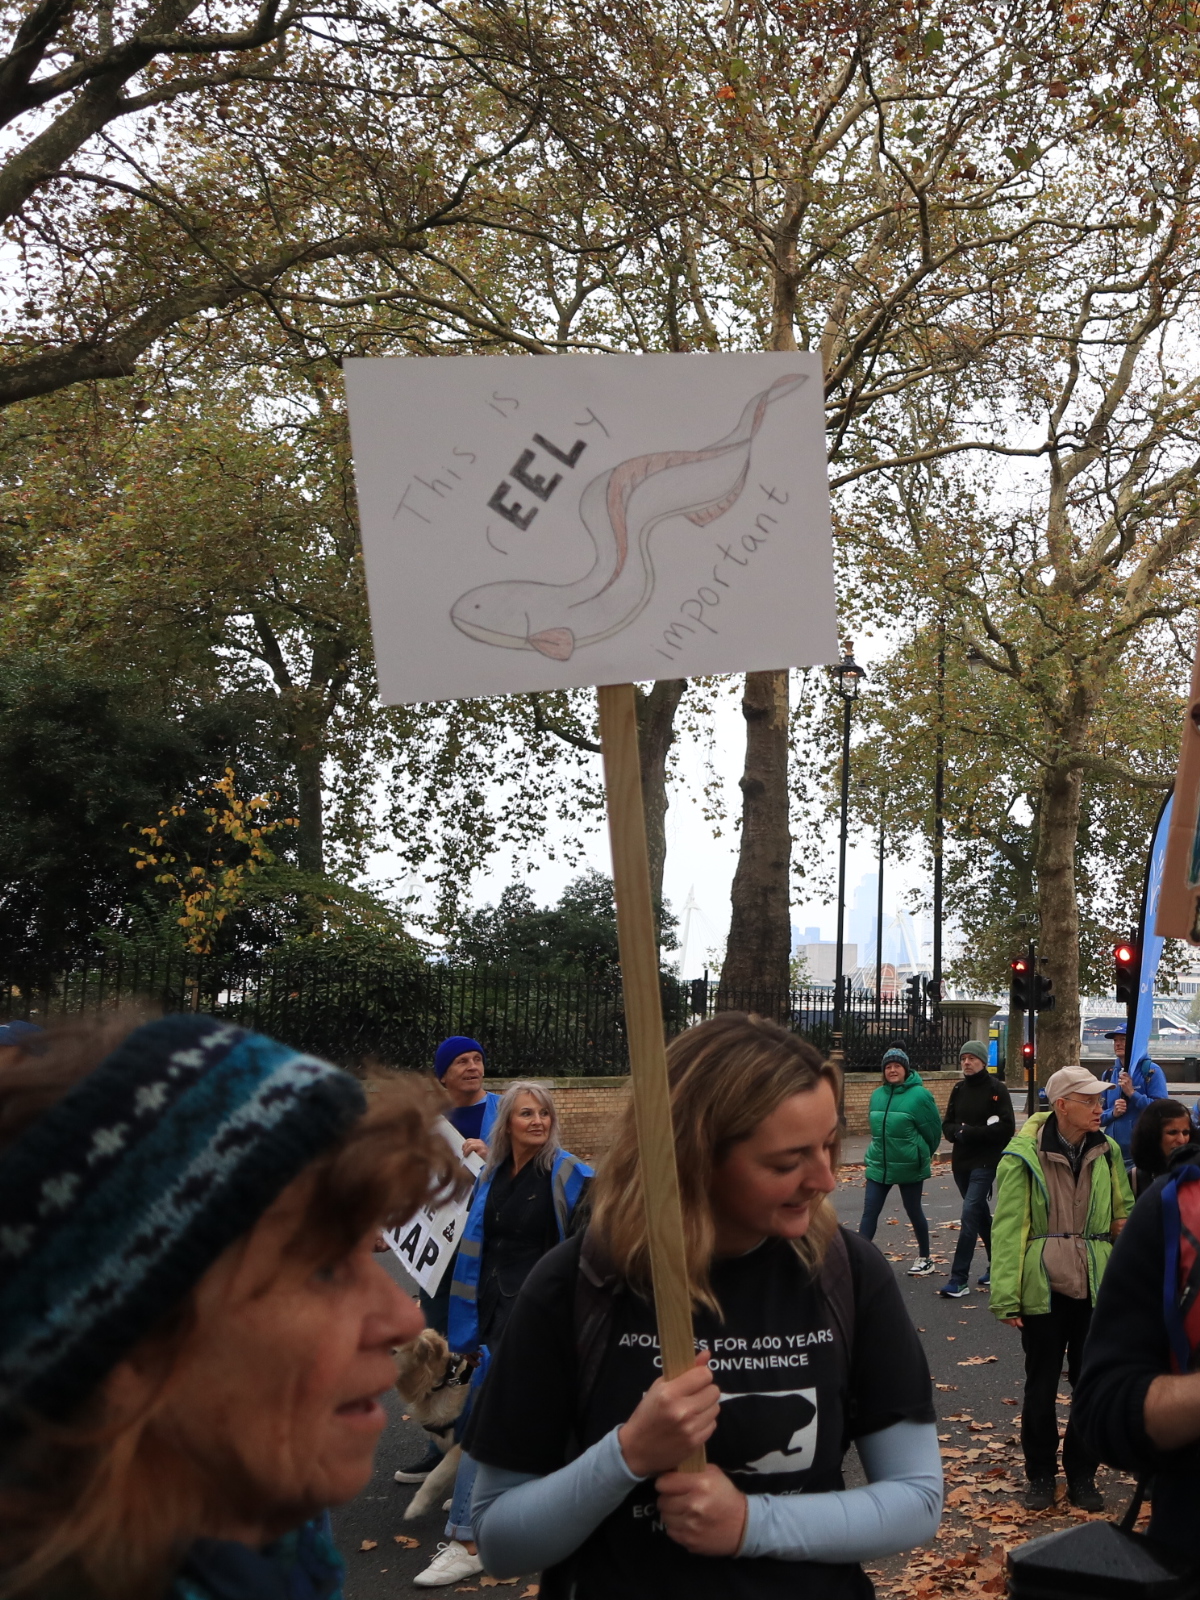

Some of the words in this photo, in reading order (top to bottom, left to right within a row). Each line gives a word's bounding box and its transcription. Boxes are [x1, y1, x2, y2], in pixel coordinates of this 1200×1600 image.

[392, 446, 476, 524] This
[485, 391, 519, 418] is
[649, 483, 789, 661] important
[707, 1353, 809, 1371] ONVENIENCE
[714, 1338, 747, 1352] FOR
[752, 1336, 781, 1350] 400
[785, 1329, 834, 1349] YEARS
